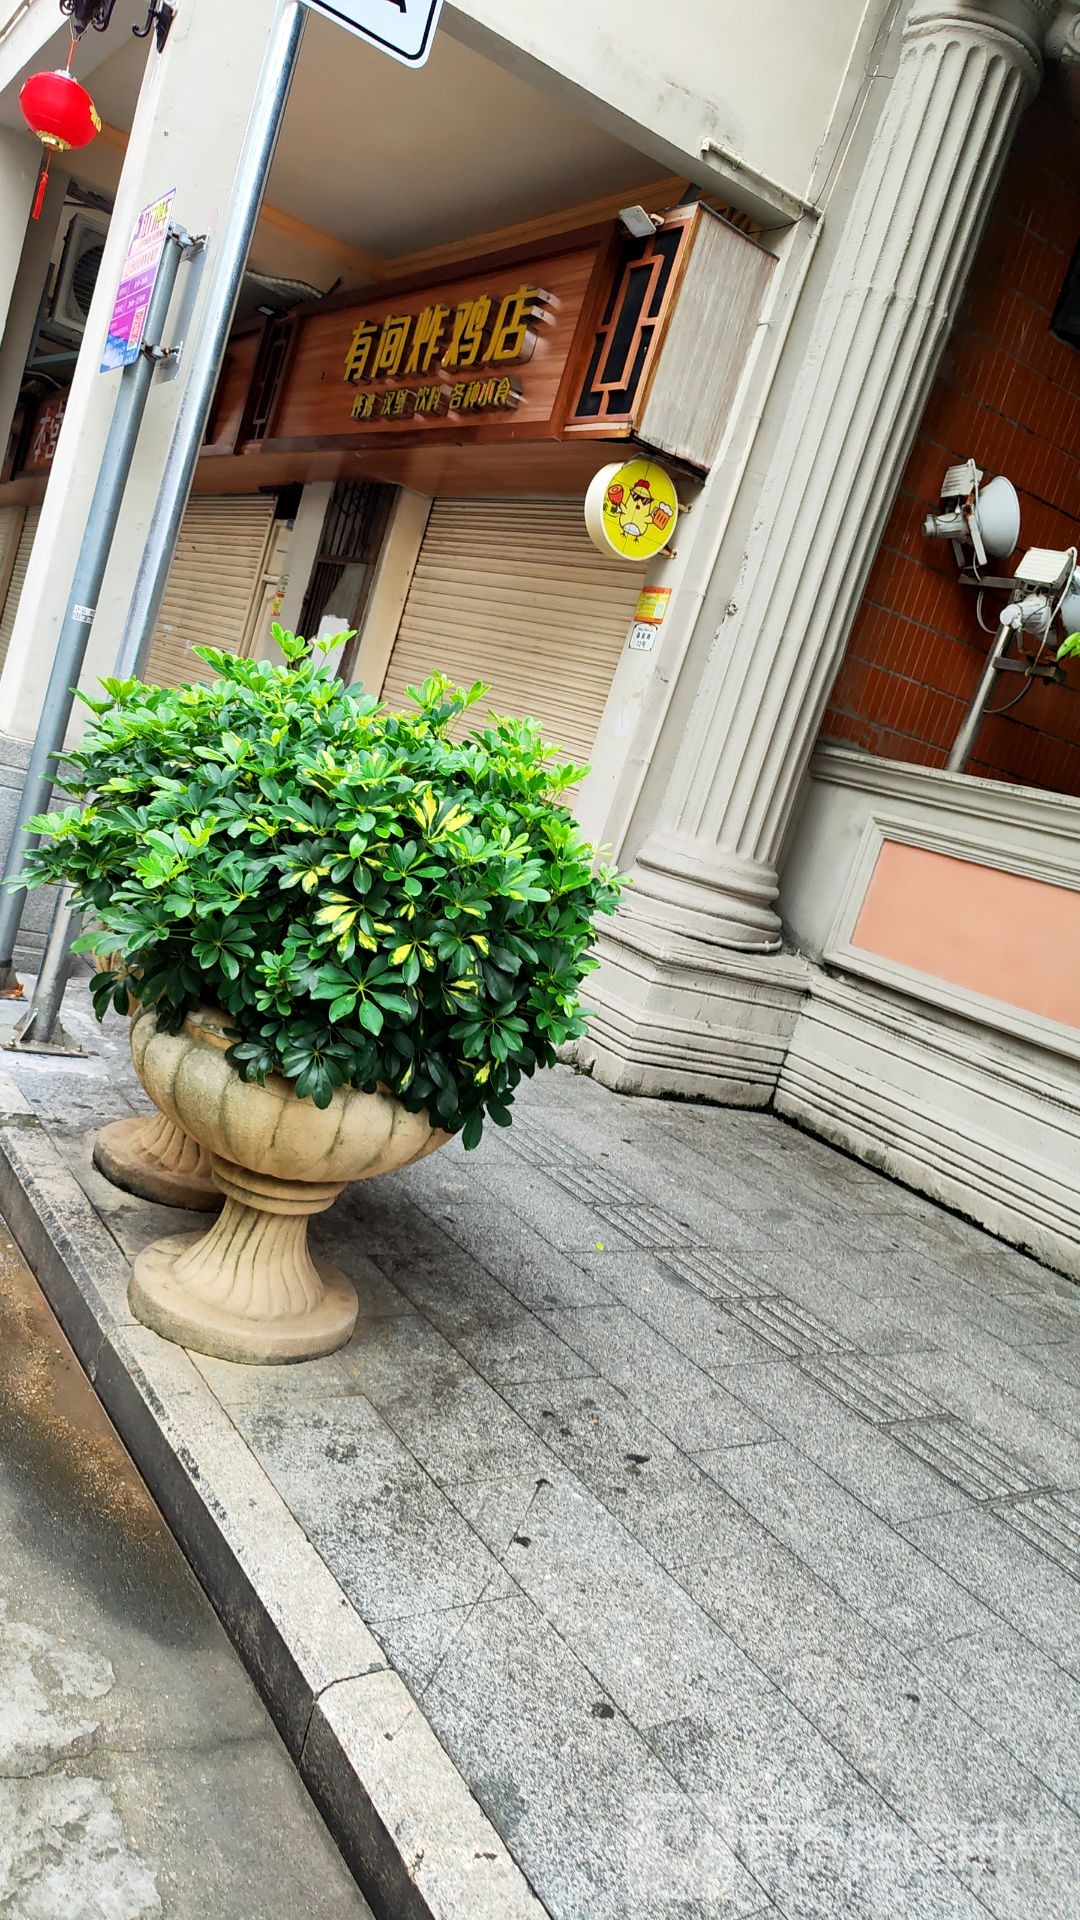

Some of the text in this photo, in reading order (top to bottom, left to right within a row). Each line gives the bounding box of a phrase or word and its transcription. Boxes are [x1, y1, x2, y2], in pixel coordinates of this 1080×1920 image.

[344, 284, 539, 381] 有间炸鸡店
[351, 377, 511, 418] 炸鸡 汉堡 饮料 各种小食
